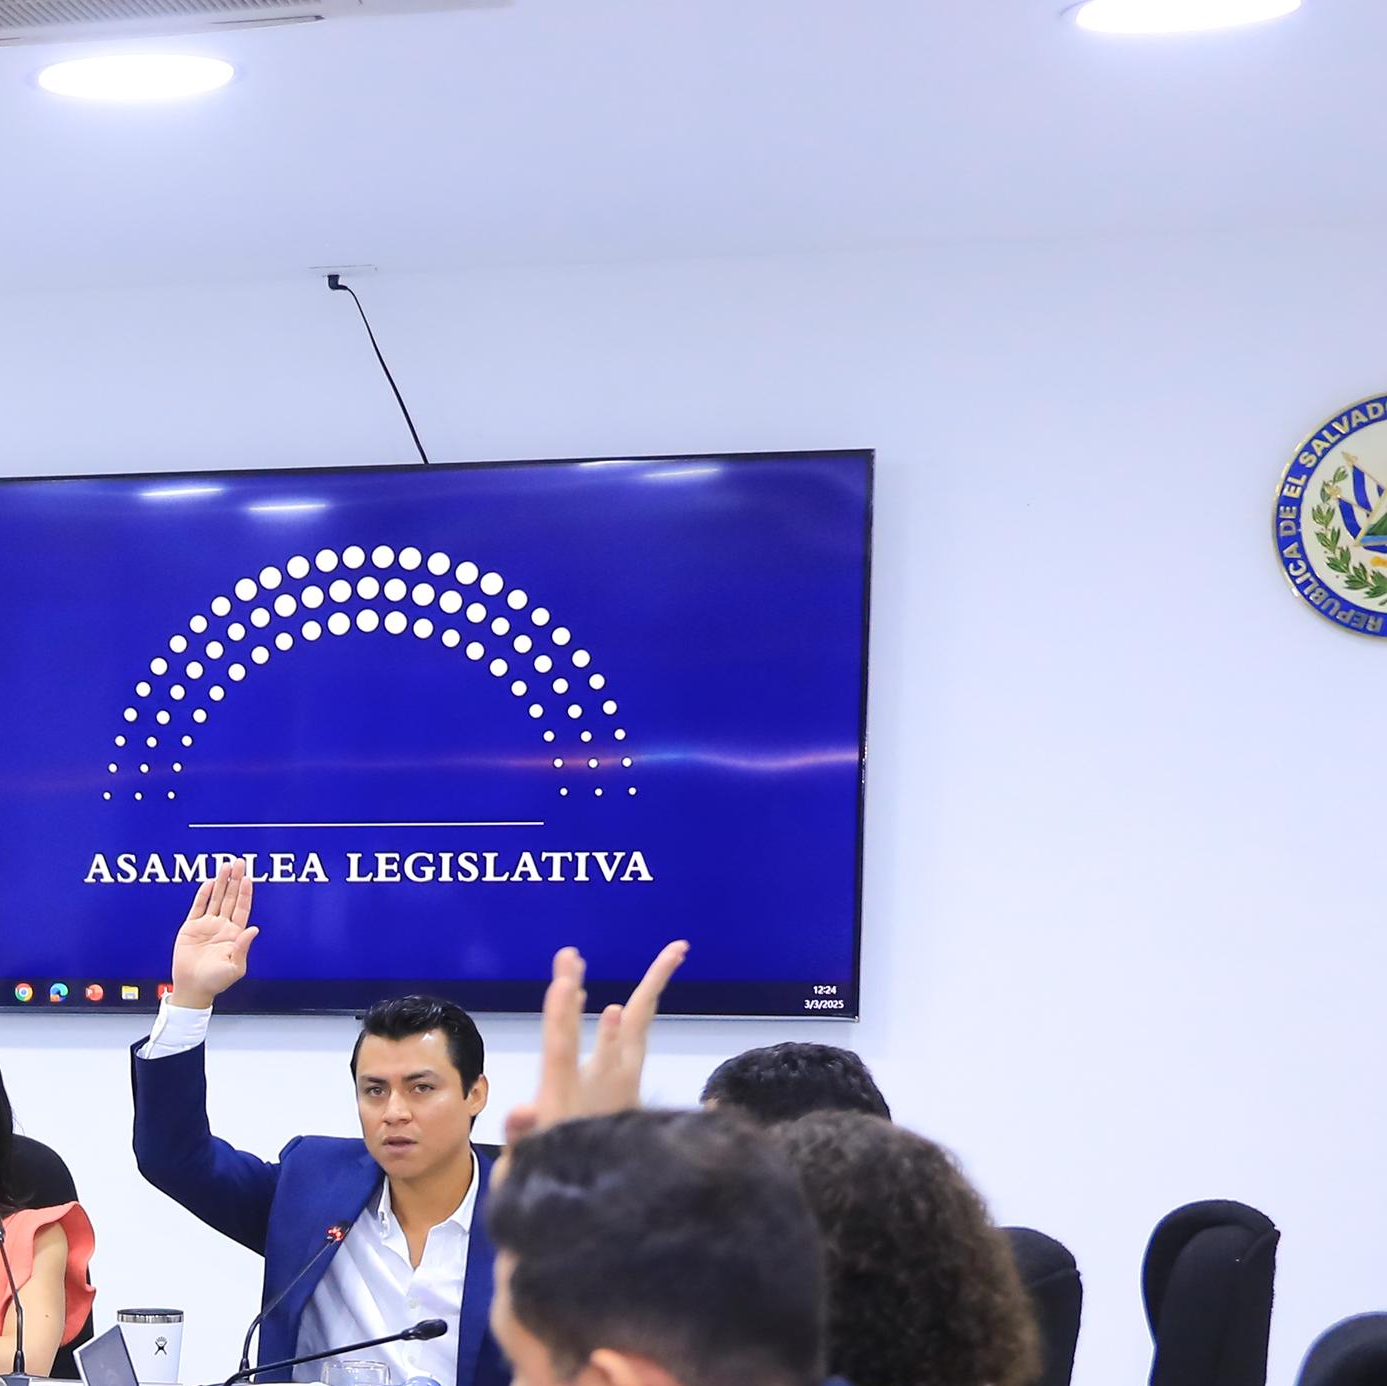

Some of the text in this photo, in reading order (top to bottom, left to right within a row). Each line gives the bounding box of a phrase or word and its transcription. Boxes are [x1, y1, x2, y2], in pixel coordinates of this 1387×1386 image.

[1279, 402, 1387, 633] REPUBLICA DE EL SALVAD
[345, 851, 655, 883] LEGISLATIVA
[813, 985, 837, 995] 12:24
[804, 999, 845, 1010] 3/3/2025
